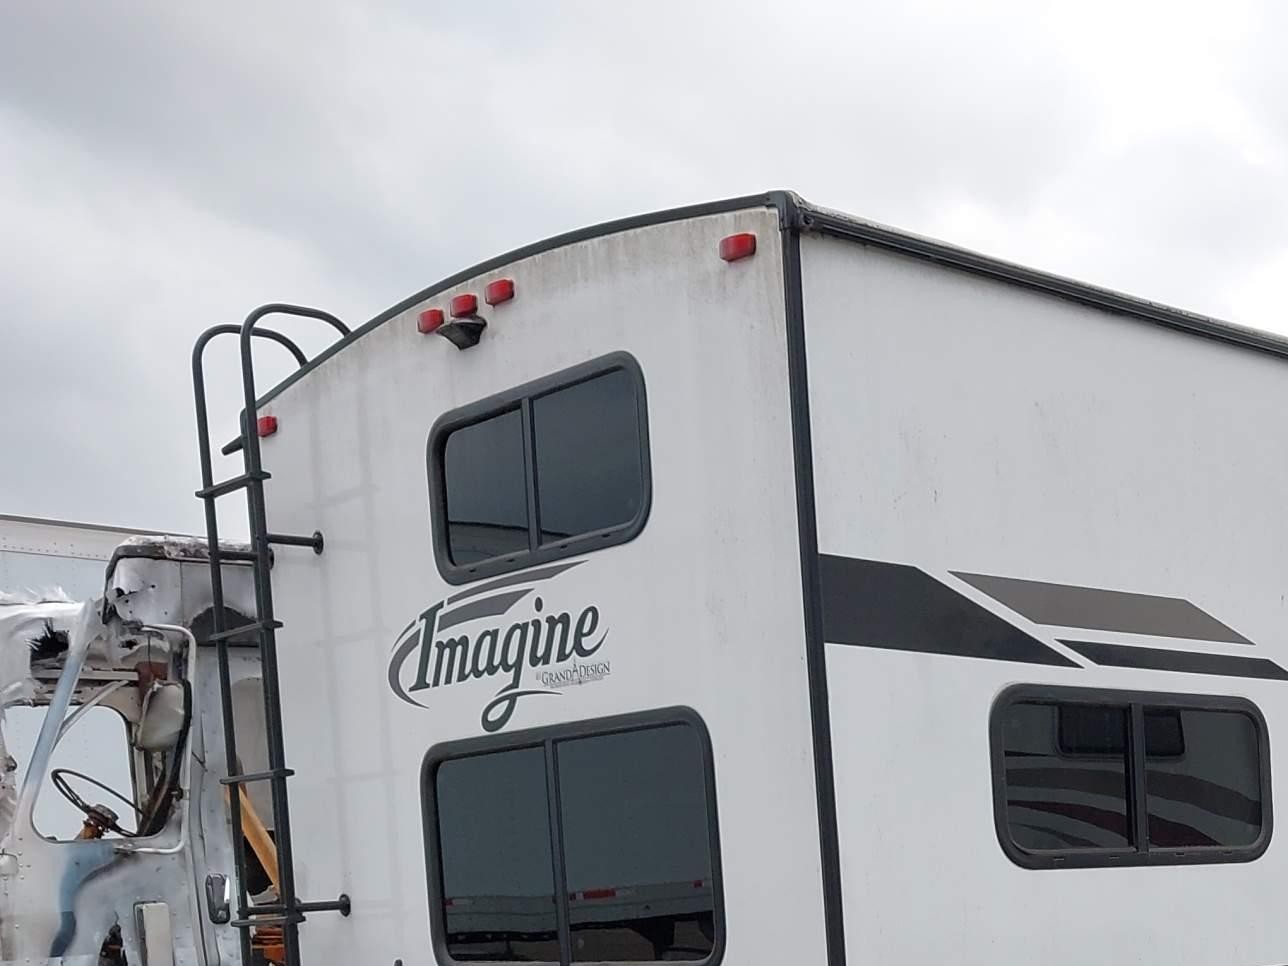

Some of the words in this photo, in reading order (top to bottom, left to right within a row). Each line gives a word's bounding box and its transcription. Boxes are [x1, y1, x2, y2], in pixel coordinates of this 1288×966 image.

[407, 596, 609, 733] Imagine
[541, 669, 572, 685] GRAND
[579, 660, 611, 677] DESIGN
